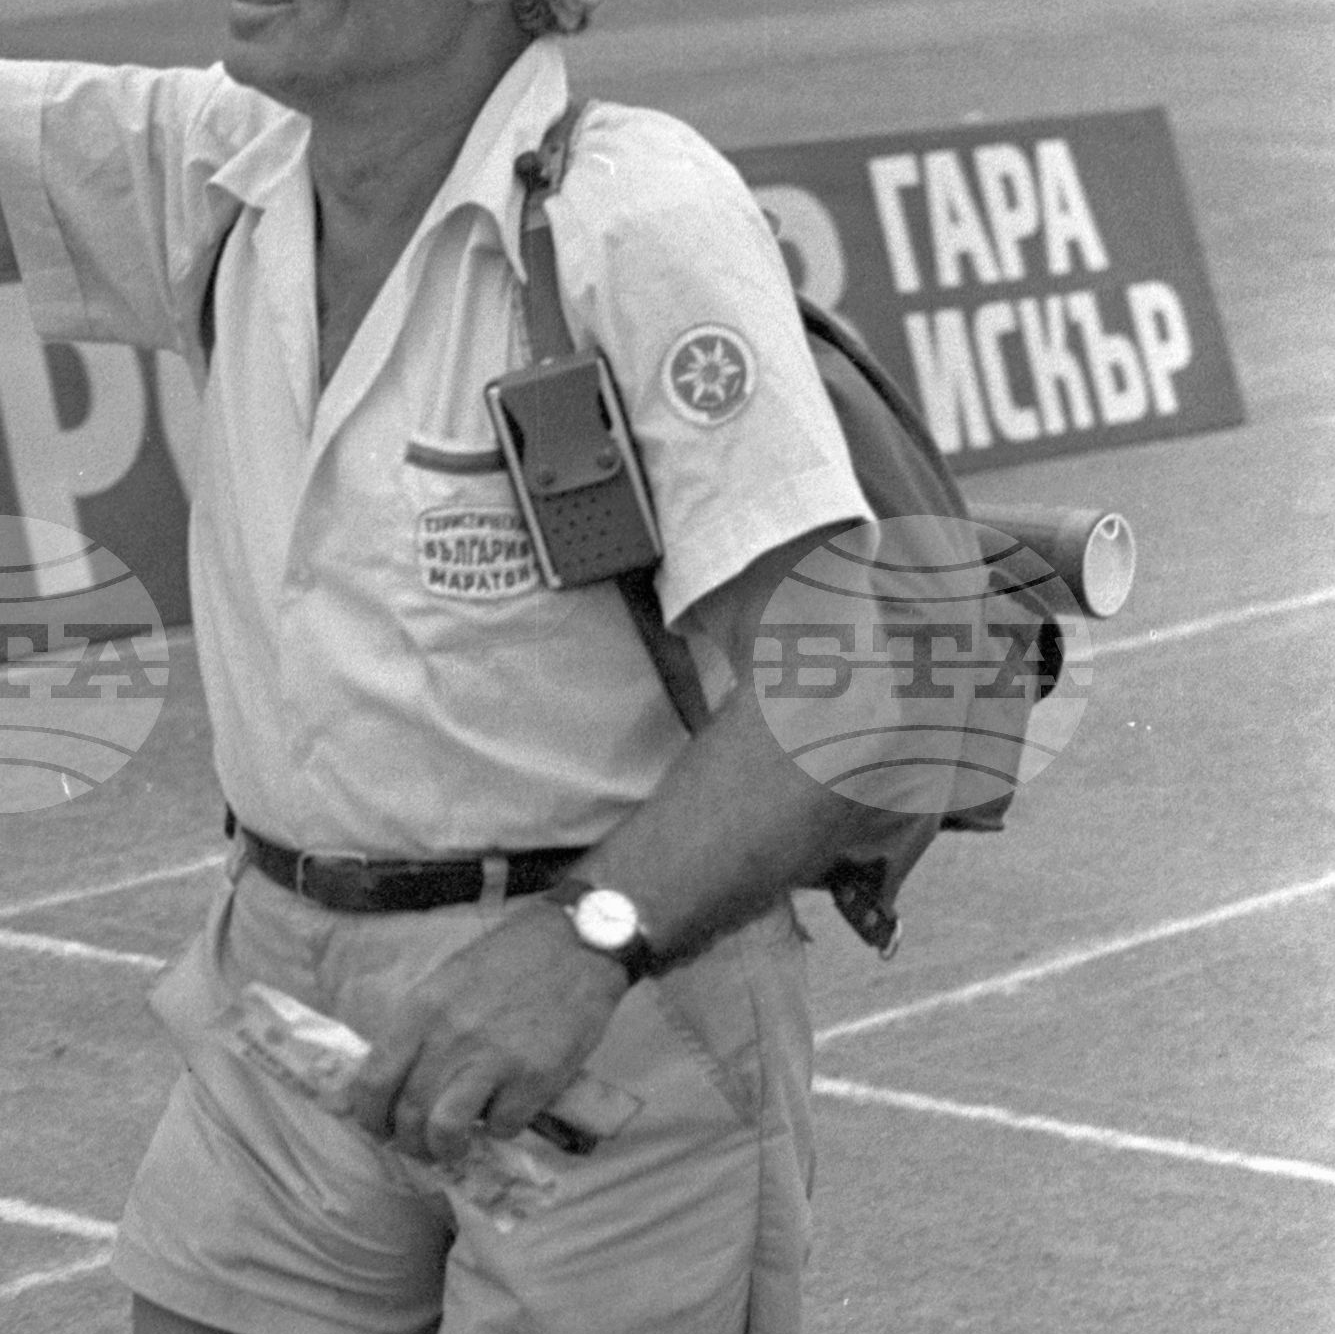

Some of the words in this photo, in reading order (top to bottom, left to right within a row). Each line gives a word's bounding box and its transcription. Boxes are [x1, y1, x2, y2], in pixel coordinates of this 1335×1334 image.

[868, 137, 1110, 294] ГАРА
[904, 279, 1193, 455] ИСКЪР
[427, 563, 531, 592] МАРАТОН
